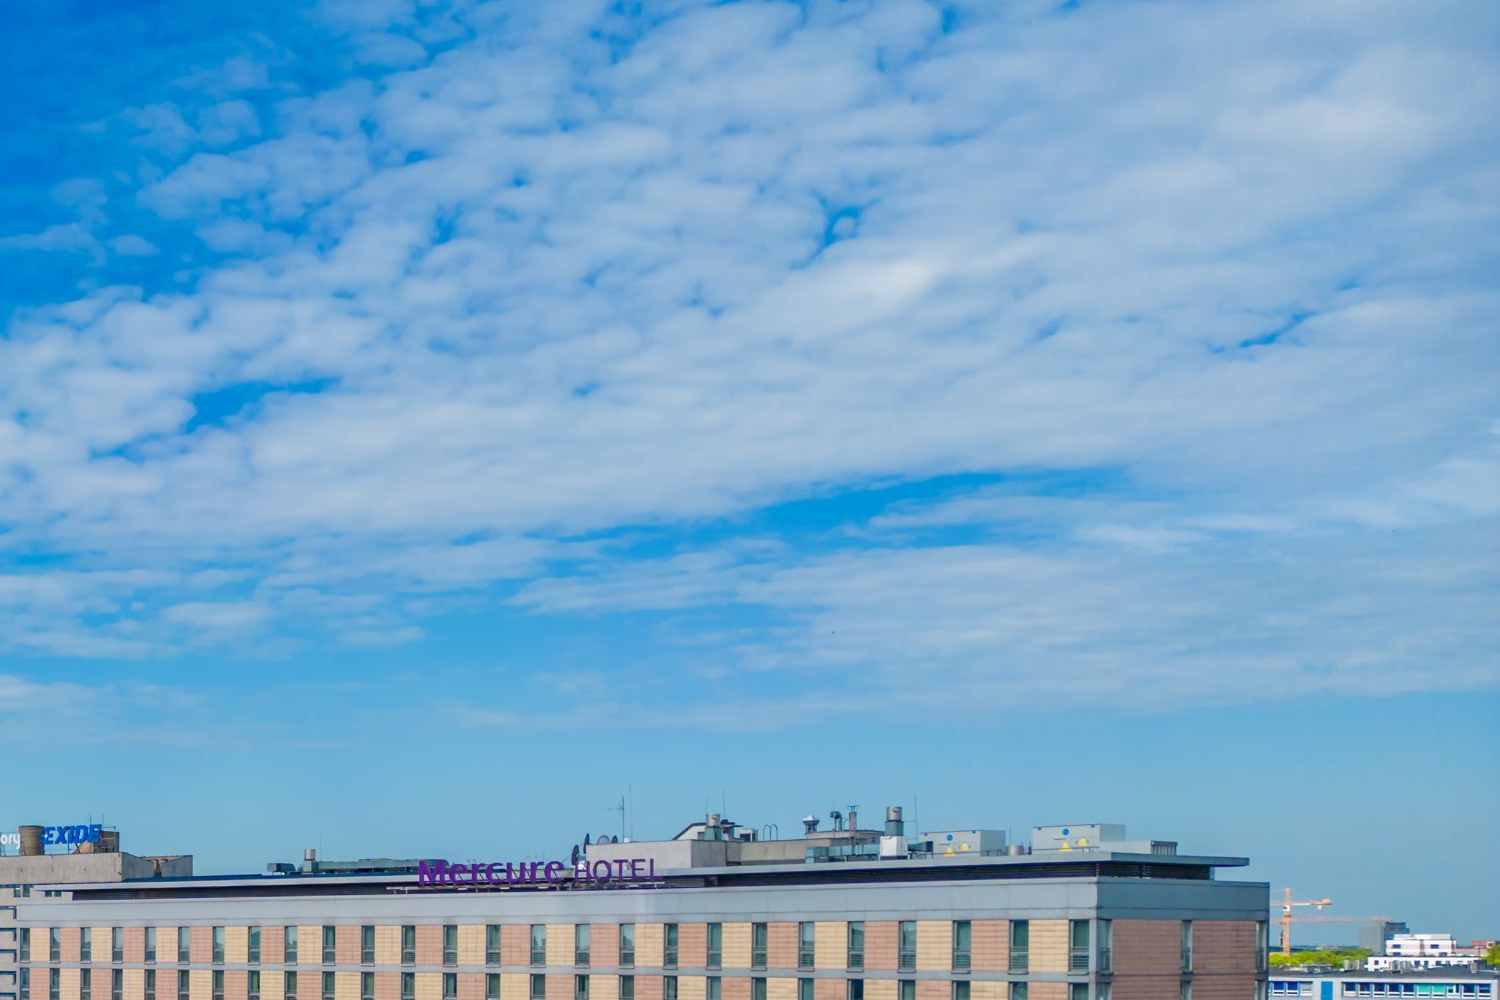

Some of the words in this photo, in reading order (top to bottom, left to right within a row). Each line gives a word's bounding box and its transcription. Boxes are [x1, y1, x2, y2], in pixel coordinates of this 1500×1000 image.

[42, 824, 102, 845] EXIDE
[418, 858, 565, 886] Mercure
[574, 858, 663, 882] HOTEL
